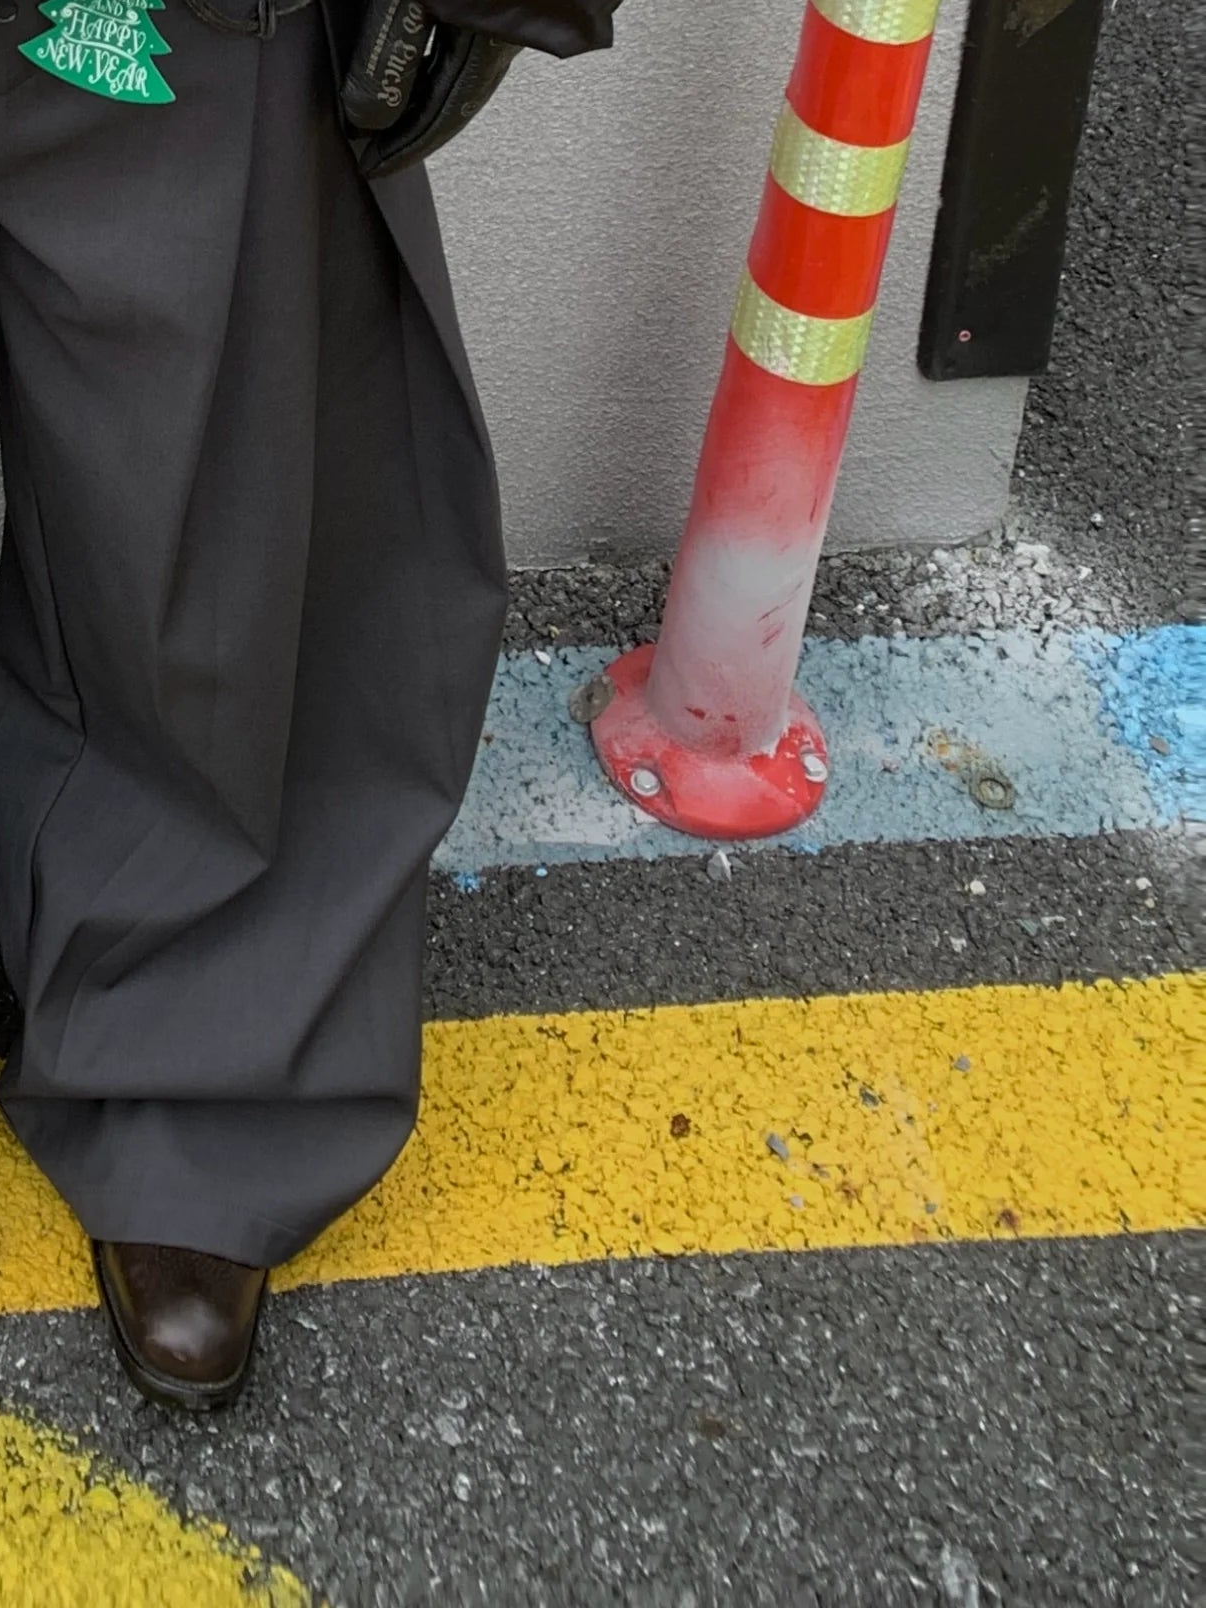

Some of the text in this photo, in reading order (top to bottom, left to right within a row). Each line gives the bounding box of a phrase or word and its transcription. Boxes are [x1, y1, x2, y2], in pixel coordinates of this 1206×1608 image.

[64, 8, 146, 56] HAPPY
[37, 38, 150, 98] NEW YEAR
